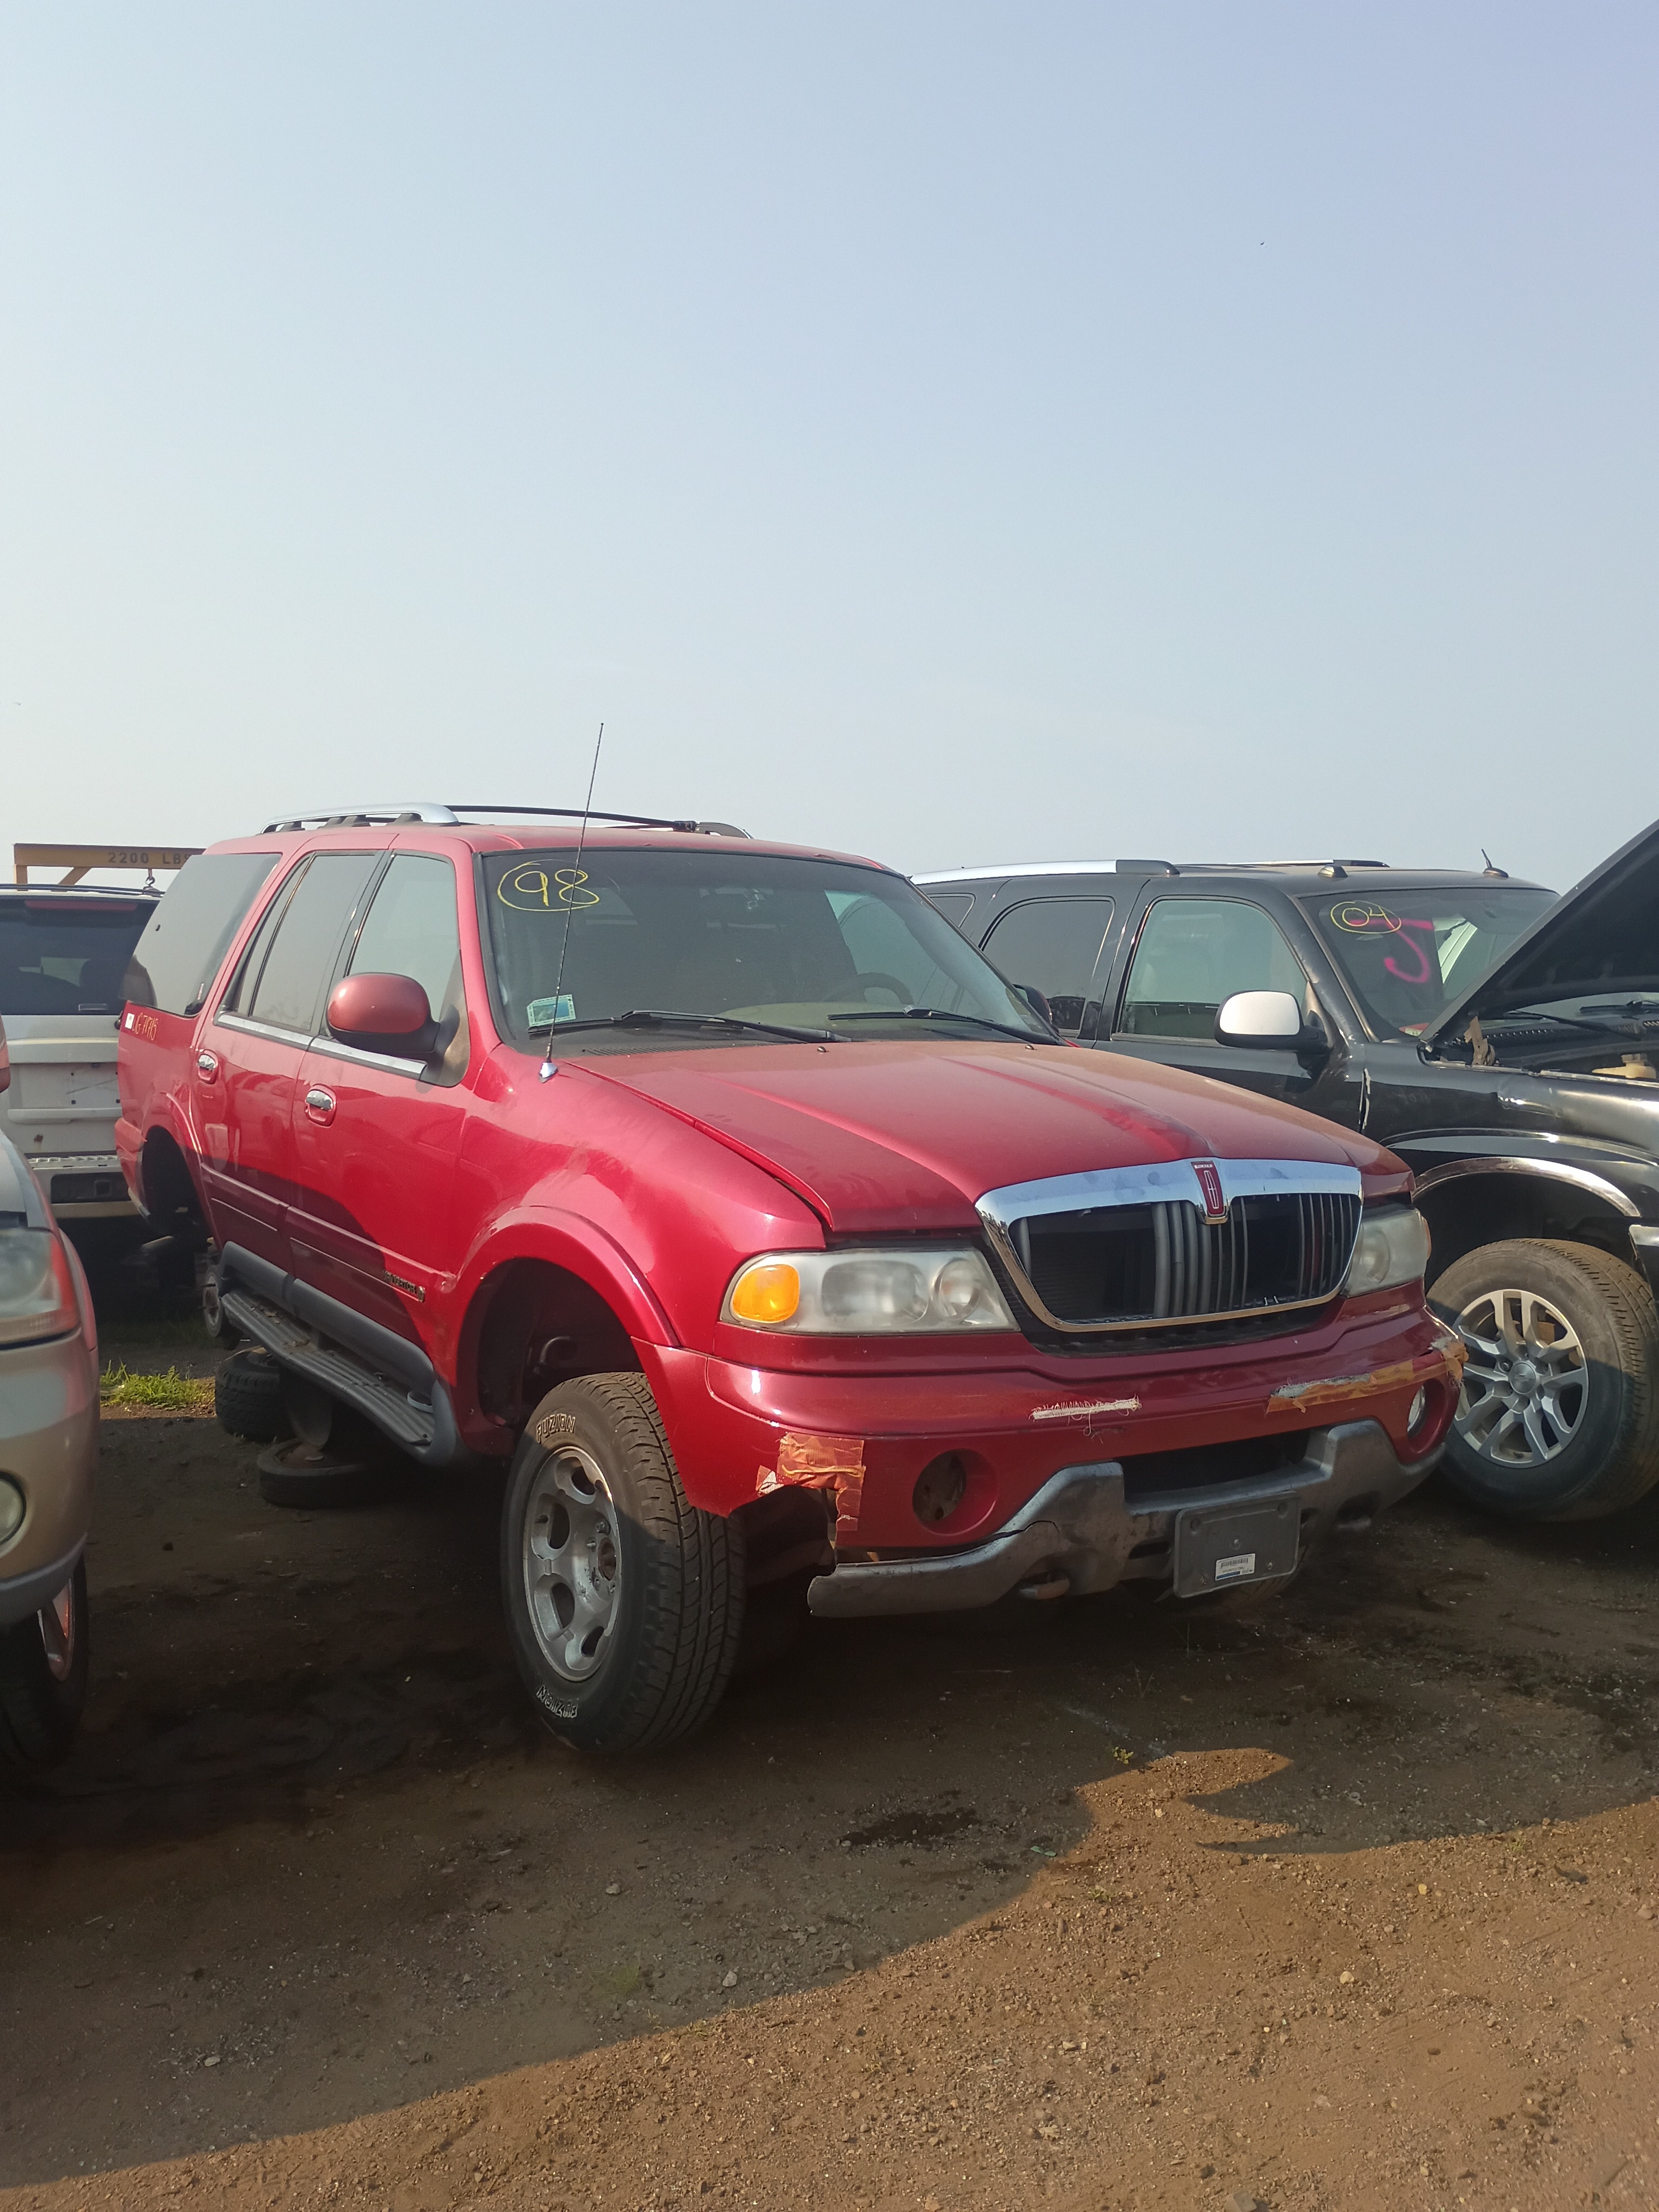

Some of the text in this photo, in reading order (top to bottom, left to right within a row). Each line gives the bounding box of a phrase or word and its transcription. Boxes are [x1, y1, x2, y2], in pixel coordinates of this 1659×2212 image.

[108, 852, 149, 864] 2200
[515, 869, 600, 906] 98
[1342, 907, 1395, 929] 04
[536, 1413, 575, 1444] FUZION
[536, 1685, 579, 1718] FUZION
